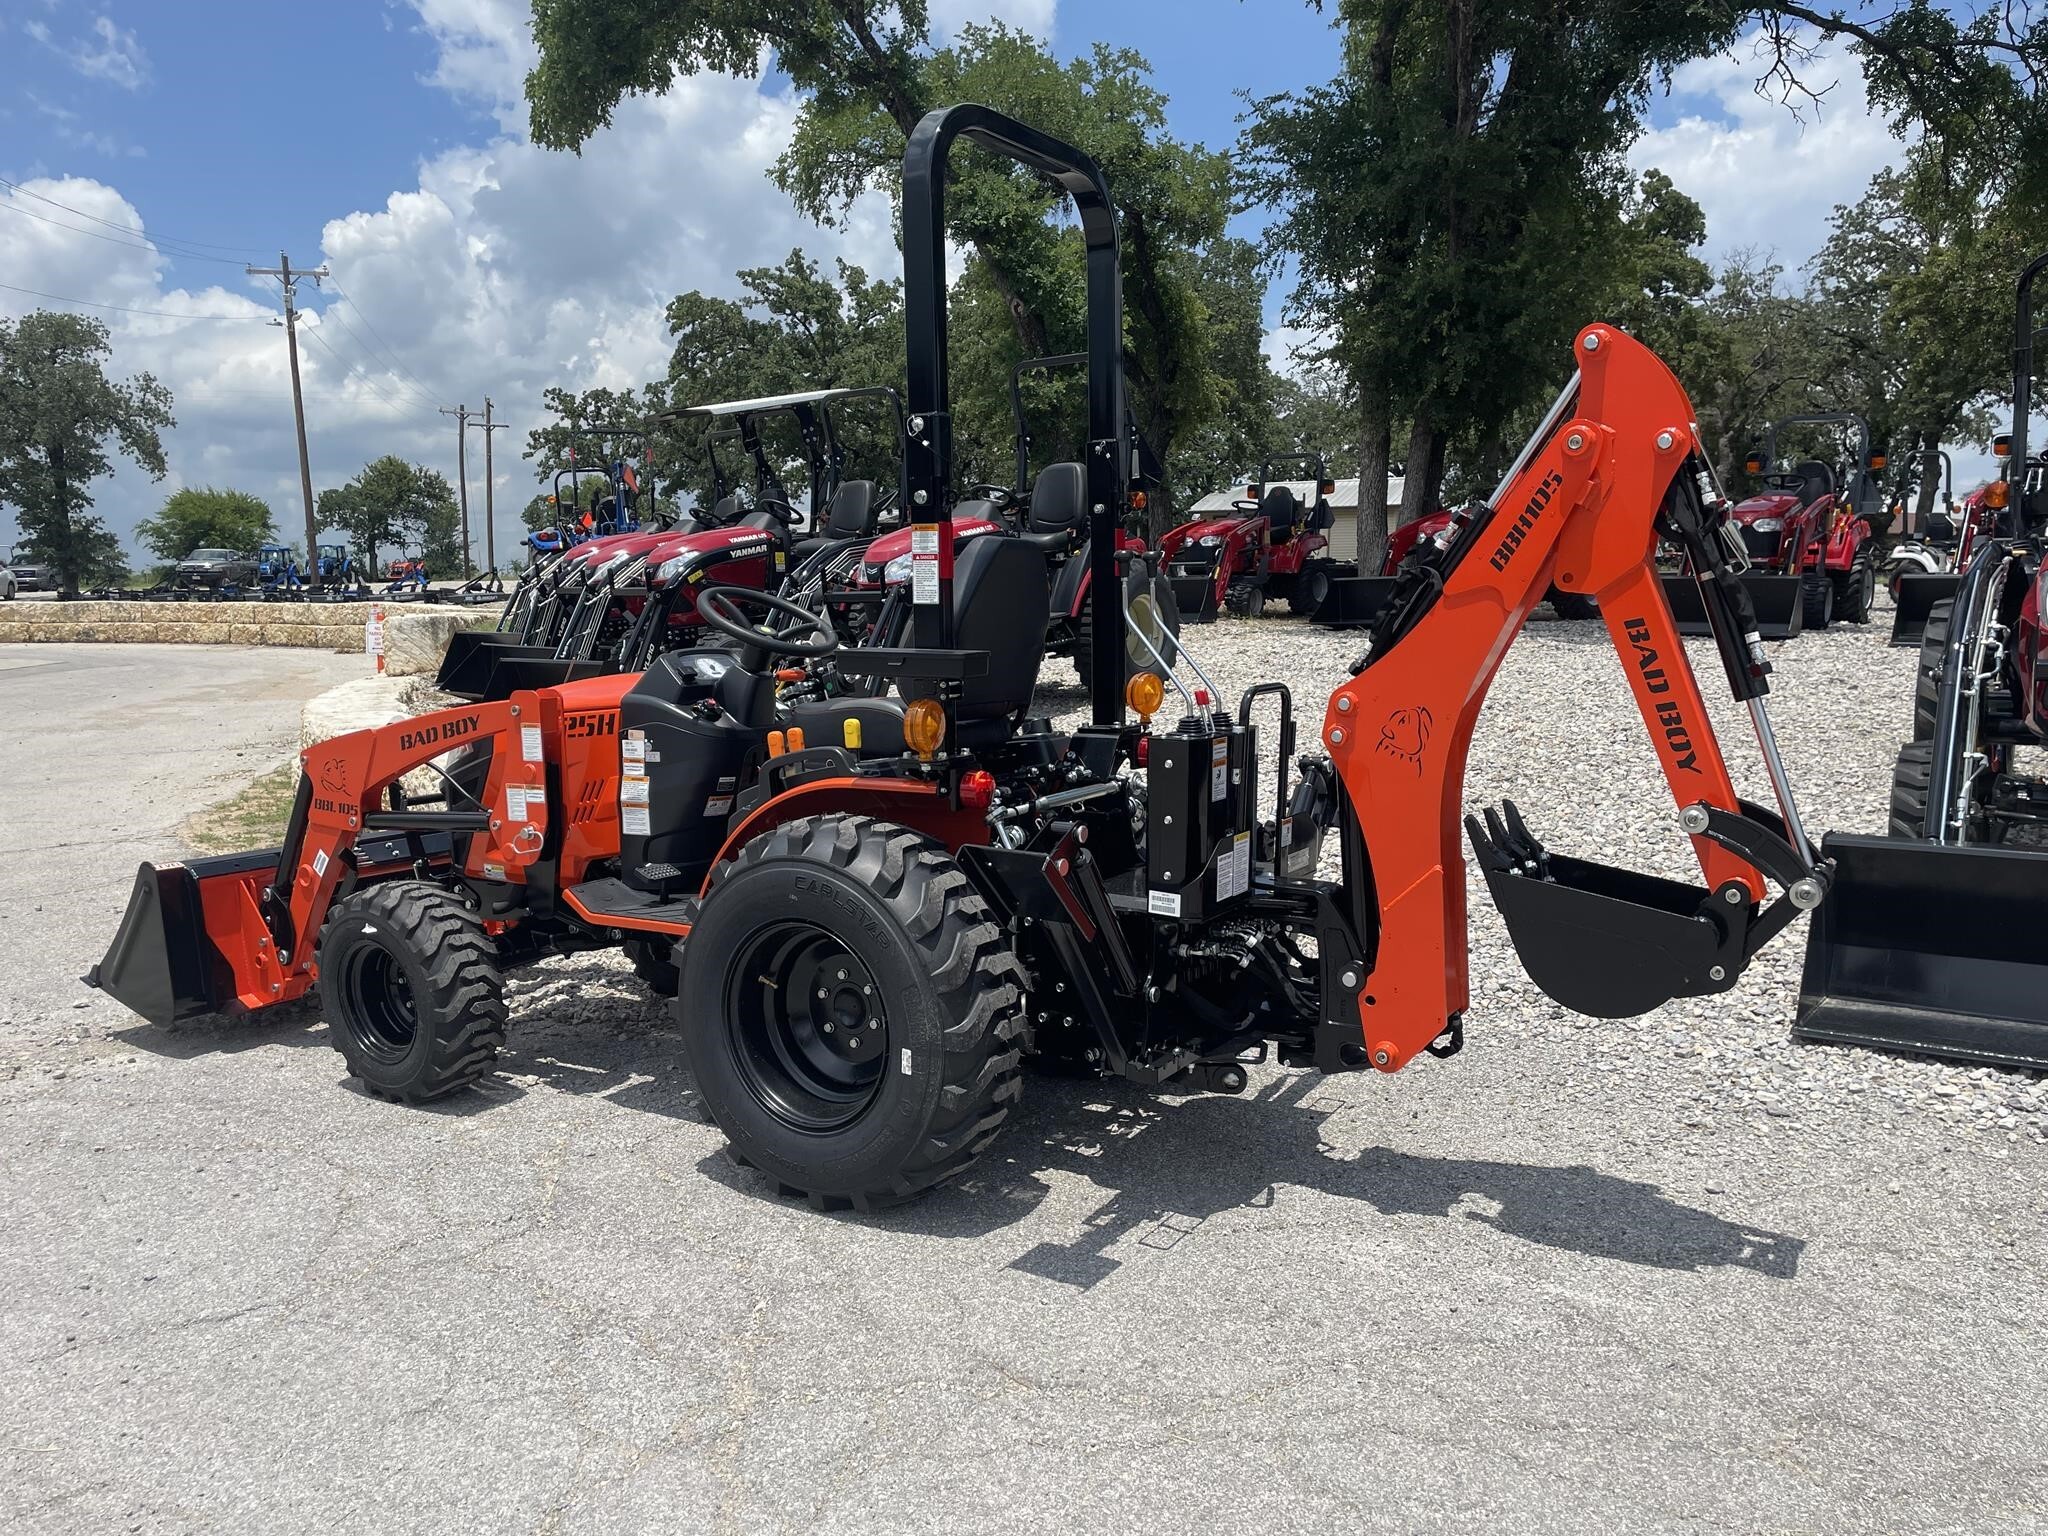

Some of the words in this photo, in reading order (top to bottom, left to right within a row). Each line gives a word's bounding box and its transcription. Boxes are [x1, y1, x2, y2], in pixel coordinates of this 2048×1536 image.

[957, 526, 986, 537] YANMAR
[1489, 468, 1563, 573] BBH105
[728, 534, 759, 544] YANMAR
[729, 544, 768, 559] YANMAR
[1623, 616, 1671, 696] BAD
[1655, 701, 1703, 776] BOY
[400, 729, 439, 751] BAD
[442, 714, 480, 740] BOY
[314, 798, 337, 813] BBL
[338, 804, 358, 817] 105
[794, 876, 890, 950] CARLSTAR
